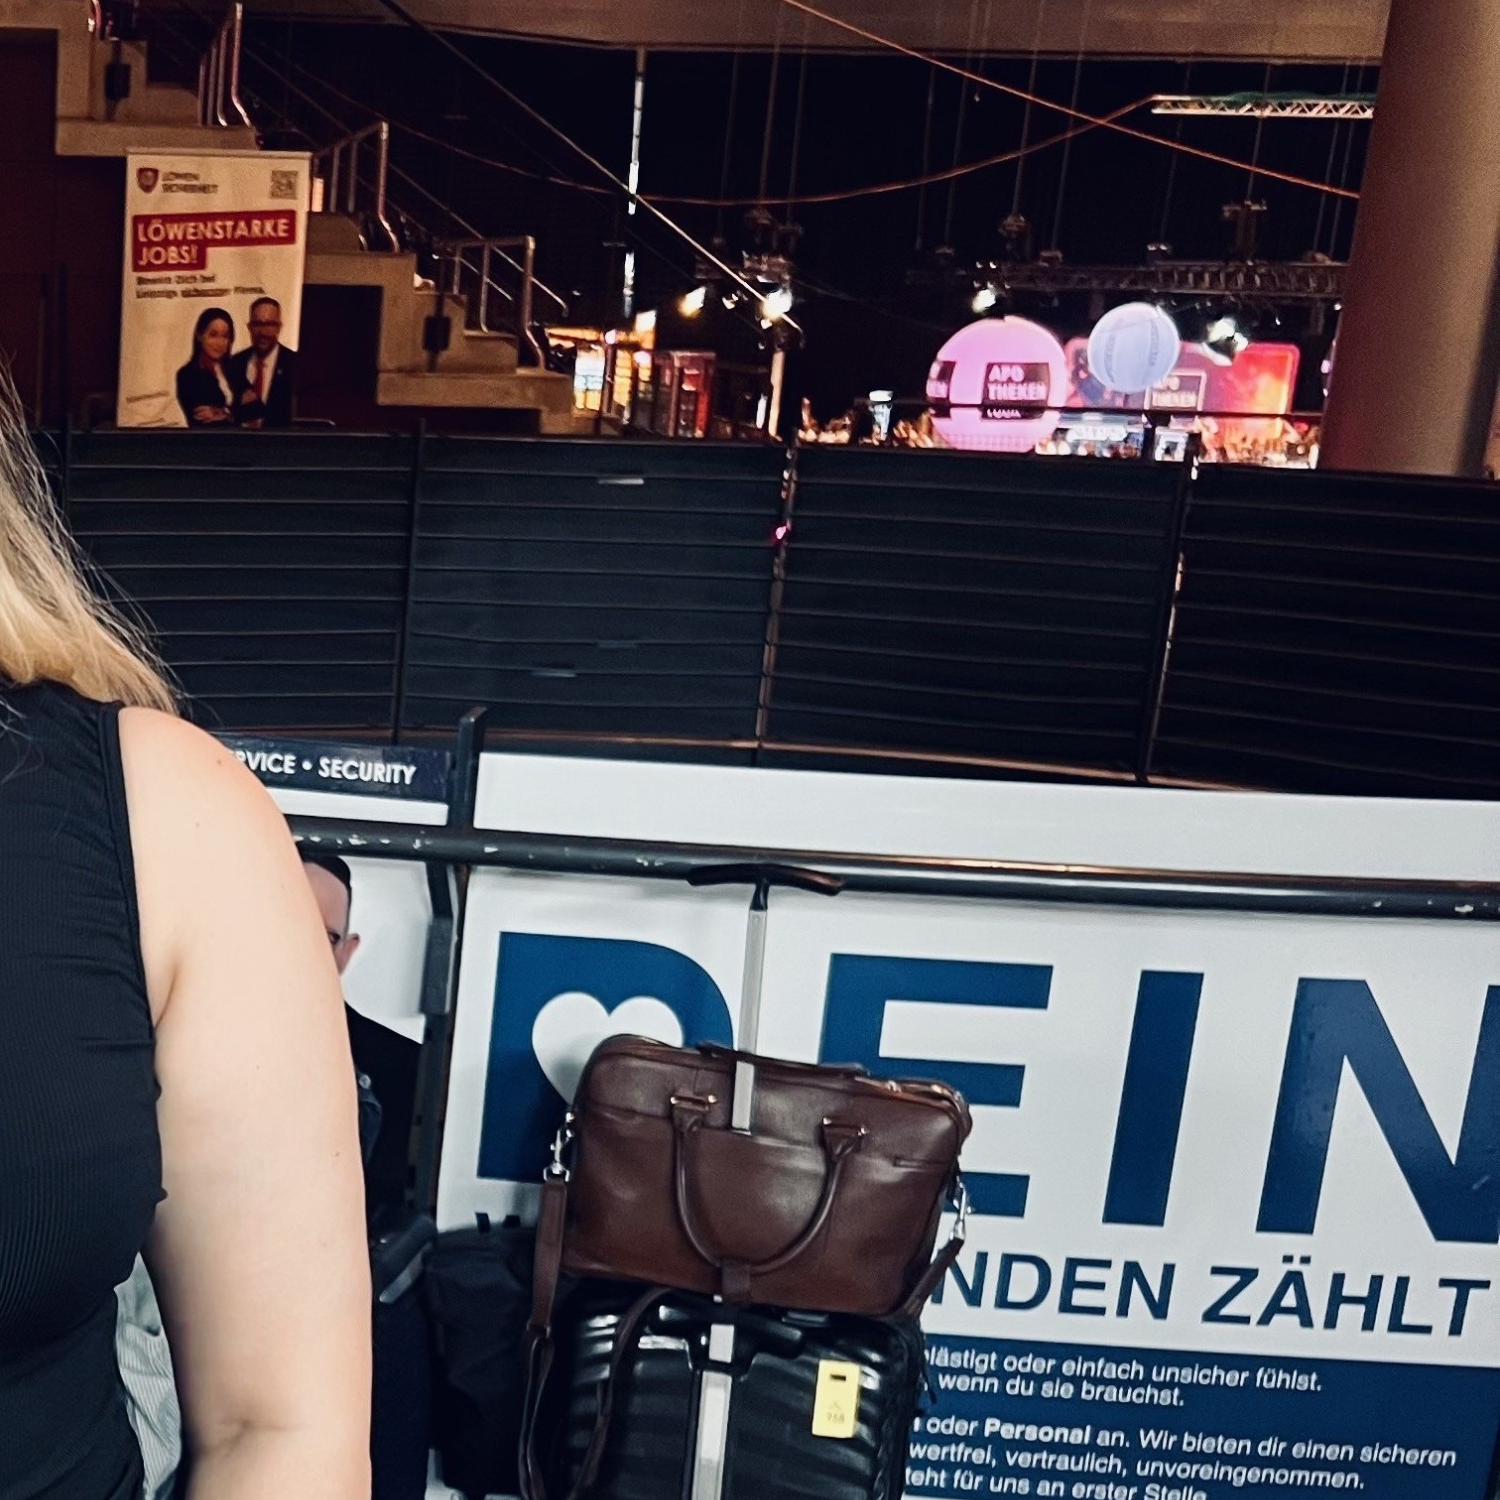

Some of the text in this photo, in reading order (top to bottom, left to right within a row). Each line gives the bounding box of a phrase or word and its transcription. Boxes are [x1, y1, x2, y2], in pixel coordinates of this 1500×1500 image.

[137, 218, 290, 242] LÖWENSTARKE
[137, 244, 198, 265] JOBS!
[228, 748, 416, 785] RVICE SECURITY
[1201, 1255, 1491, 1337] ZÄHLT
[938, 1373, 999, 1393] wenn
[1005, 1375, 1035, 1396] du
[1041, 1377, 1074, 1399] sie
[1081, 1380, 1184, 1406] brauchst.
[1003, 1353, 1056, 1375] oder
[1062, 1356, 1144, 1380] einfach
[1152, 1363, 1250, 1387] unsicher
[1256, 1366, 1322, 1391] fühlst.
[926, 1415, 978, 1436] oder
[984, 1417, 1091, 1445] Personal
[1096, 1429, 1130, 1448] an.
[1140, 1428, 1177, 1451] Wir
[1182, 1431, 1251, 1455] bieten
[1257, 1437, 1287, 1458] dir
[1292, 1439, 1354, 1461] einen
[1360, 1442, 1456, 1467] sicheren
[909, 1442, 1365, 1490] wertfrei, vertraulich, unvoreingenommen.
[953, 1469, 983, 1490] für
[989, 1476, 1030, 1495] uns
[1036, 1479, 1064, 1497] an
